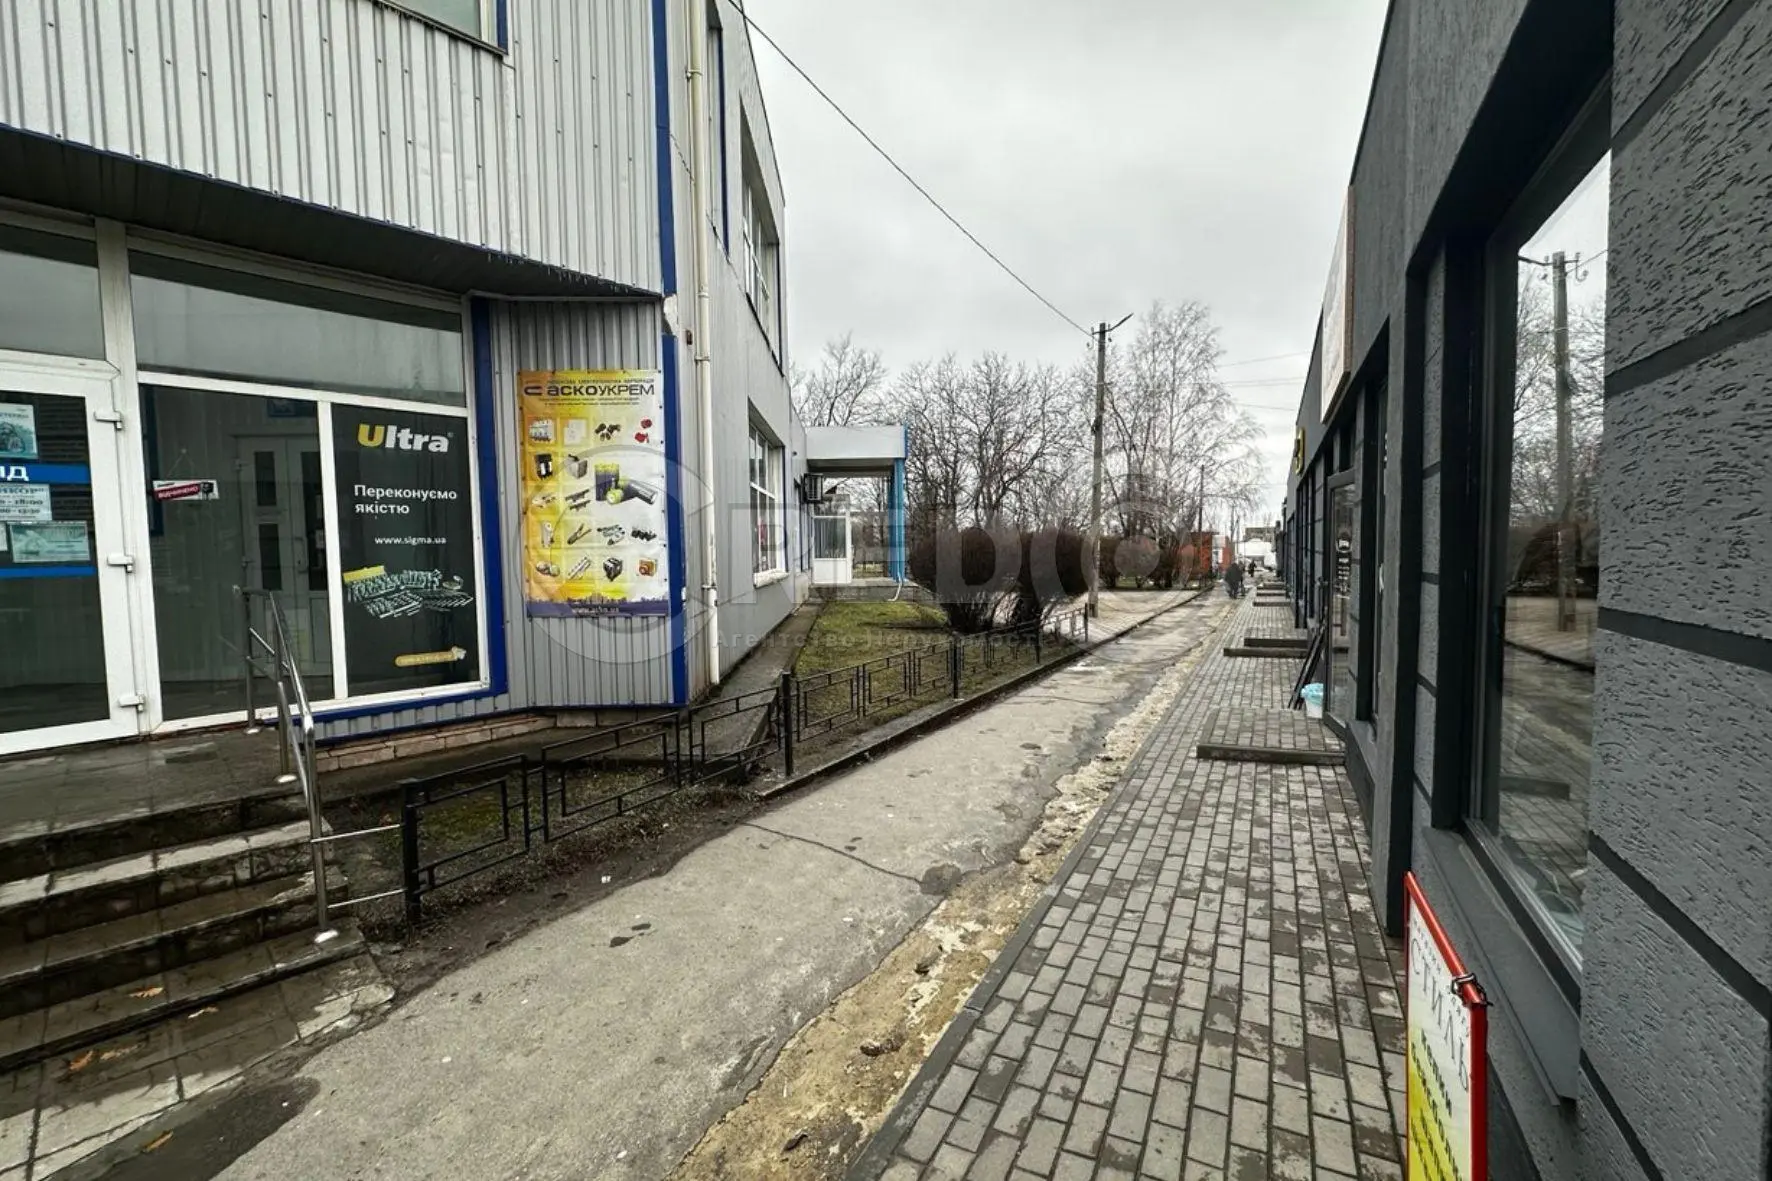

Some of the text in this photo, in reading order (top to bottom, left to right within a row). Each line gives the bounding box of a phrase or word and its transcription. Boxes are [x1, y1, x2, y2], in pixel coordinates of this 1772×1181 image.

[357, 423, 450, 453] Ultra
[354, 484, 457, 502] Переконуємо
[355, 500, 410, 514] якістю
[374, 535, 447, 546] www.sigma.ua
[1411, 938, 1470, 1093] СТИЛЬ
